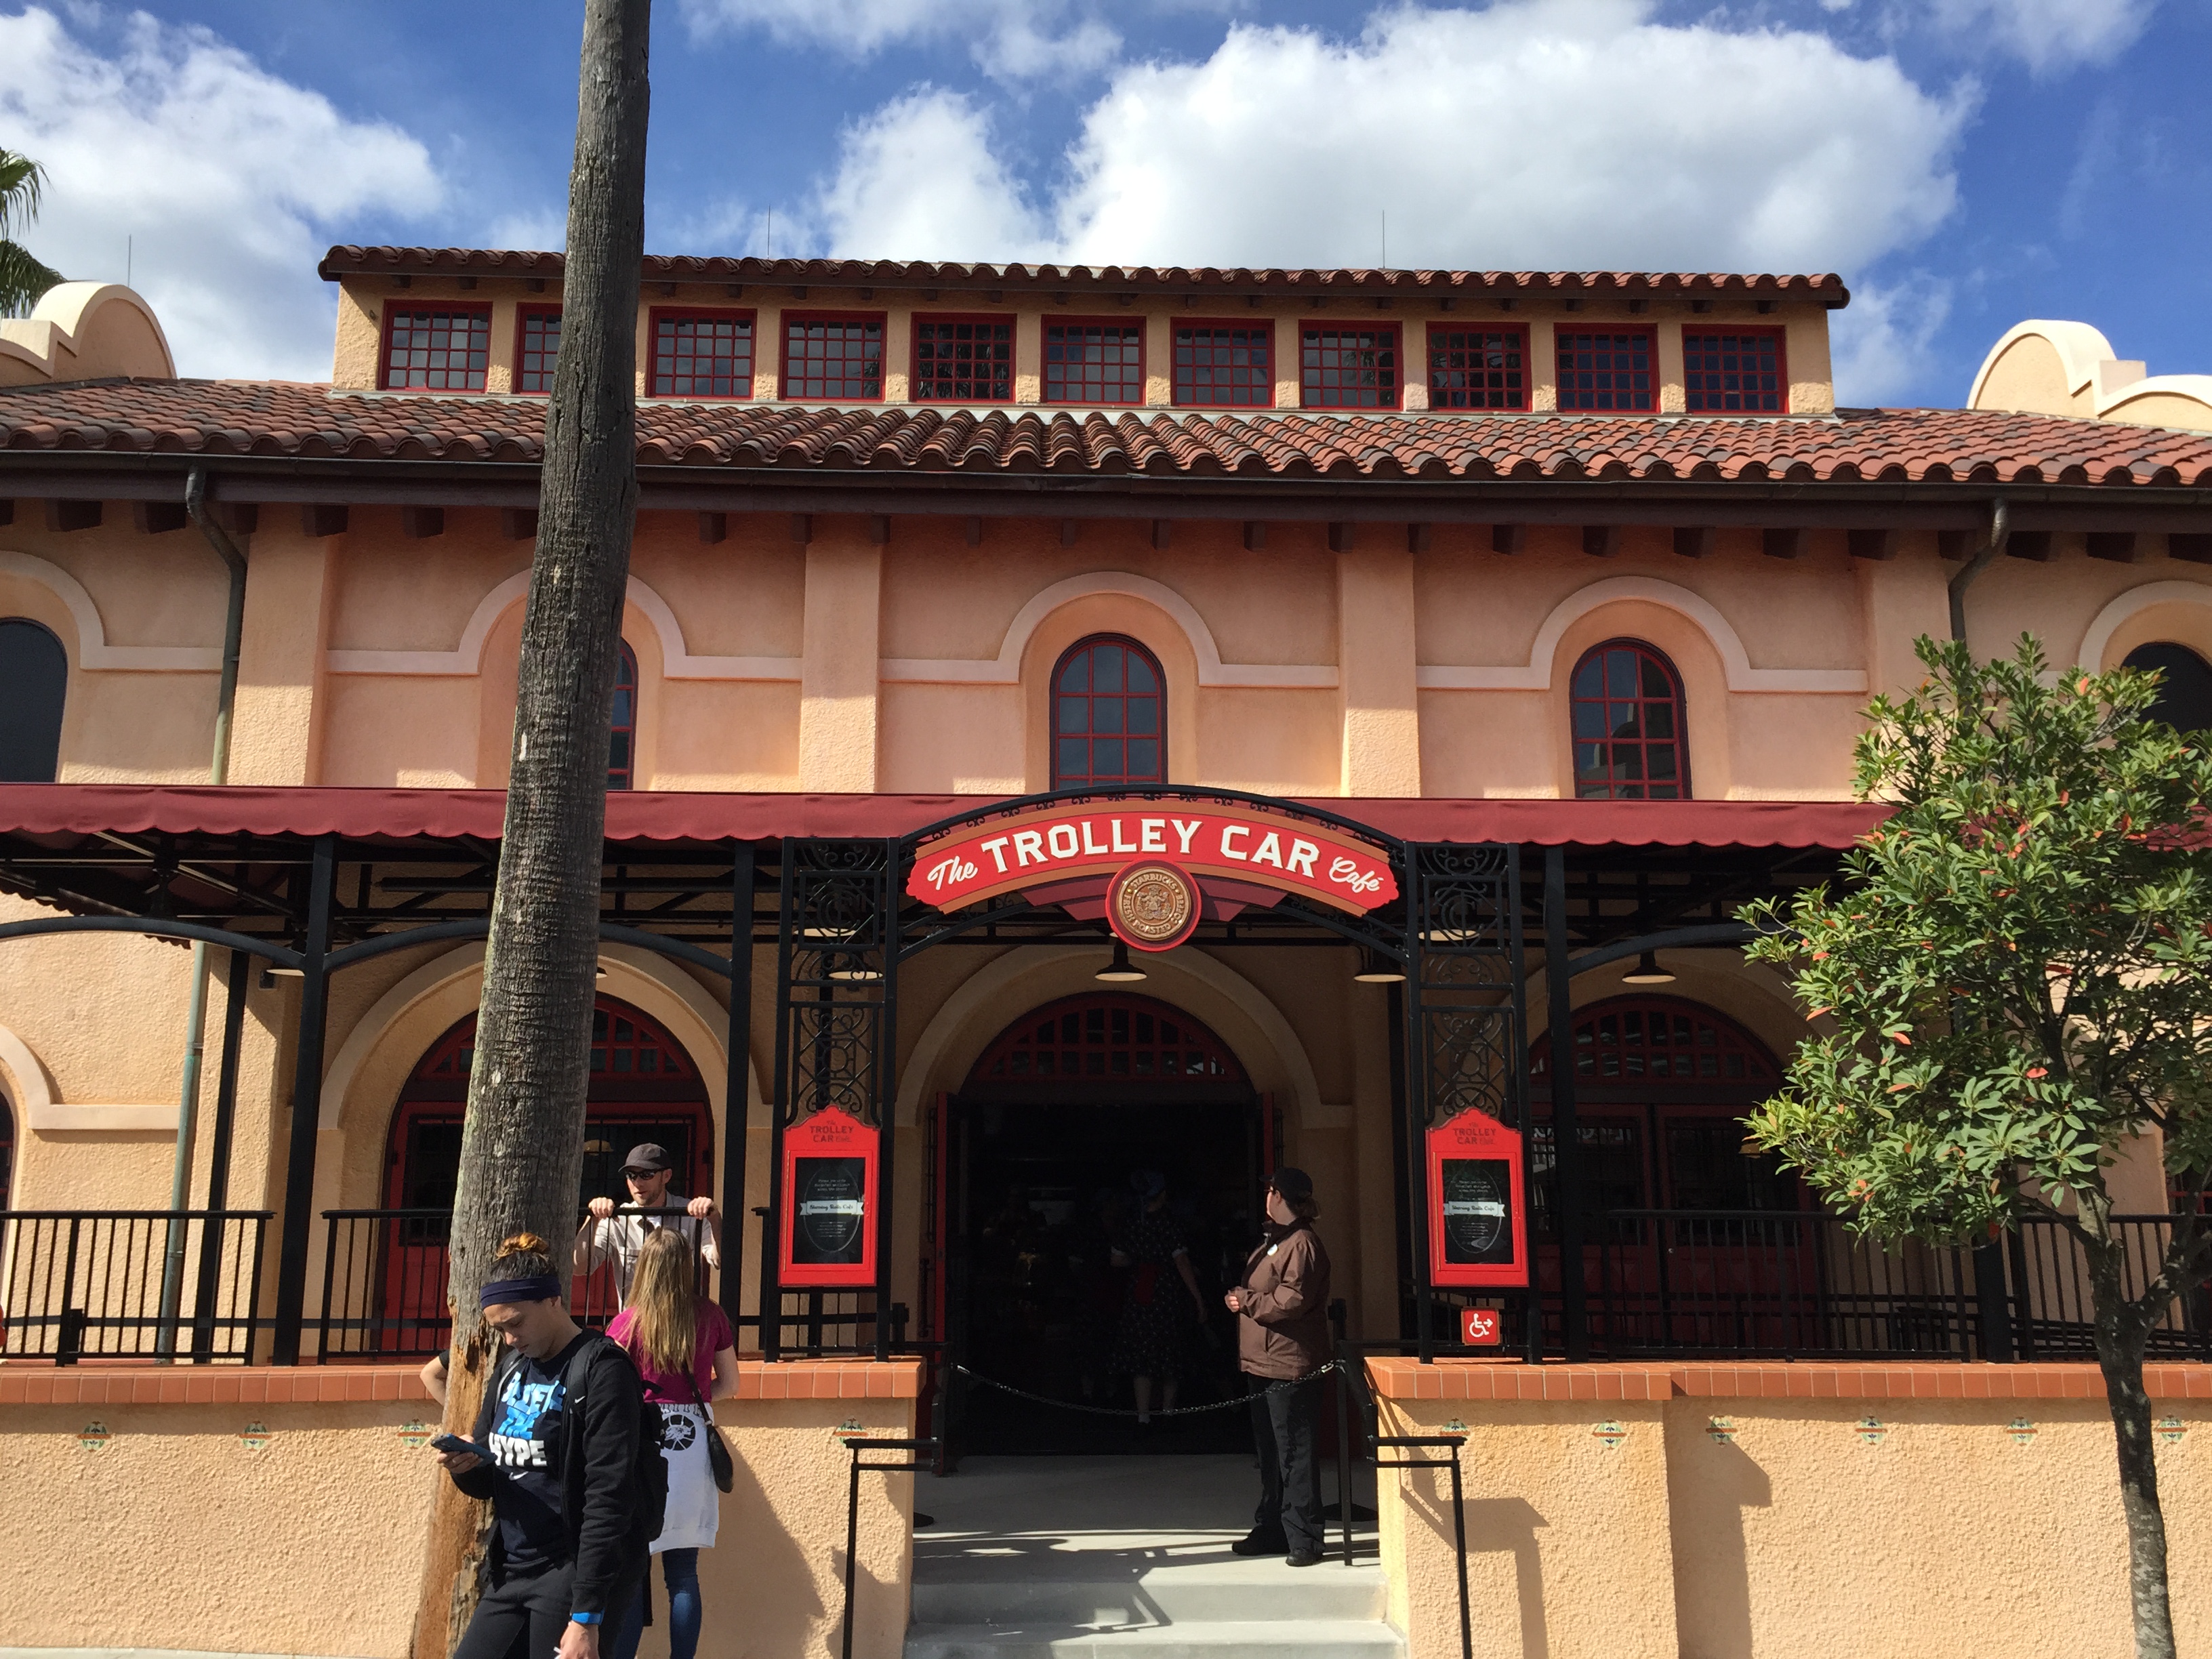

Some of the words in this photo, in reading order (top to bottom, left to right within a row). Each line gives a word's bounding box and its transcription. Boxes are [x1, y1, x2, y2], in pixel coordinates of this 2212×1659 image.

[926, 855, 979, 891] The
[981, 818, 1204, 874] TROLLEY
[1220, 825, 1320, 879] CAR
[1328, 855, 1385, 893] Café
[1130, 873, 1178, 890] STARBUCKS
[810, 1126, 854, 1134] TROLLEY
[1452, 1128, 1496, 1136] TROLLEY
[813, 1134, 834, 1143] CAR
[1456, 1136, 1478, 1145] CAR
[488, 1431, 548, 1467] HYPE
